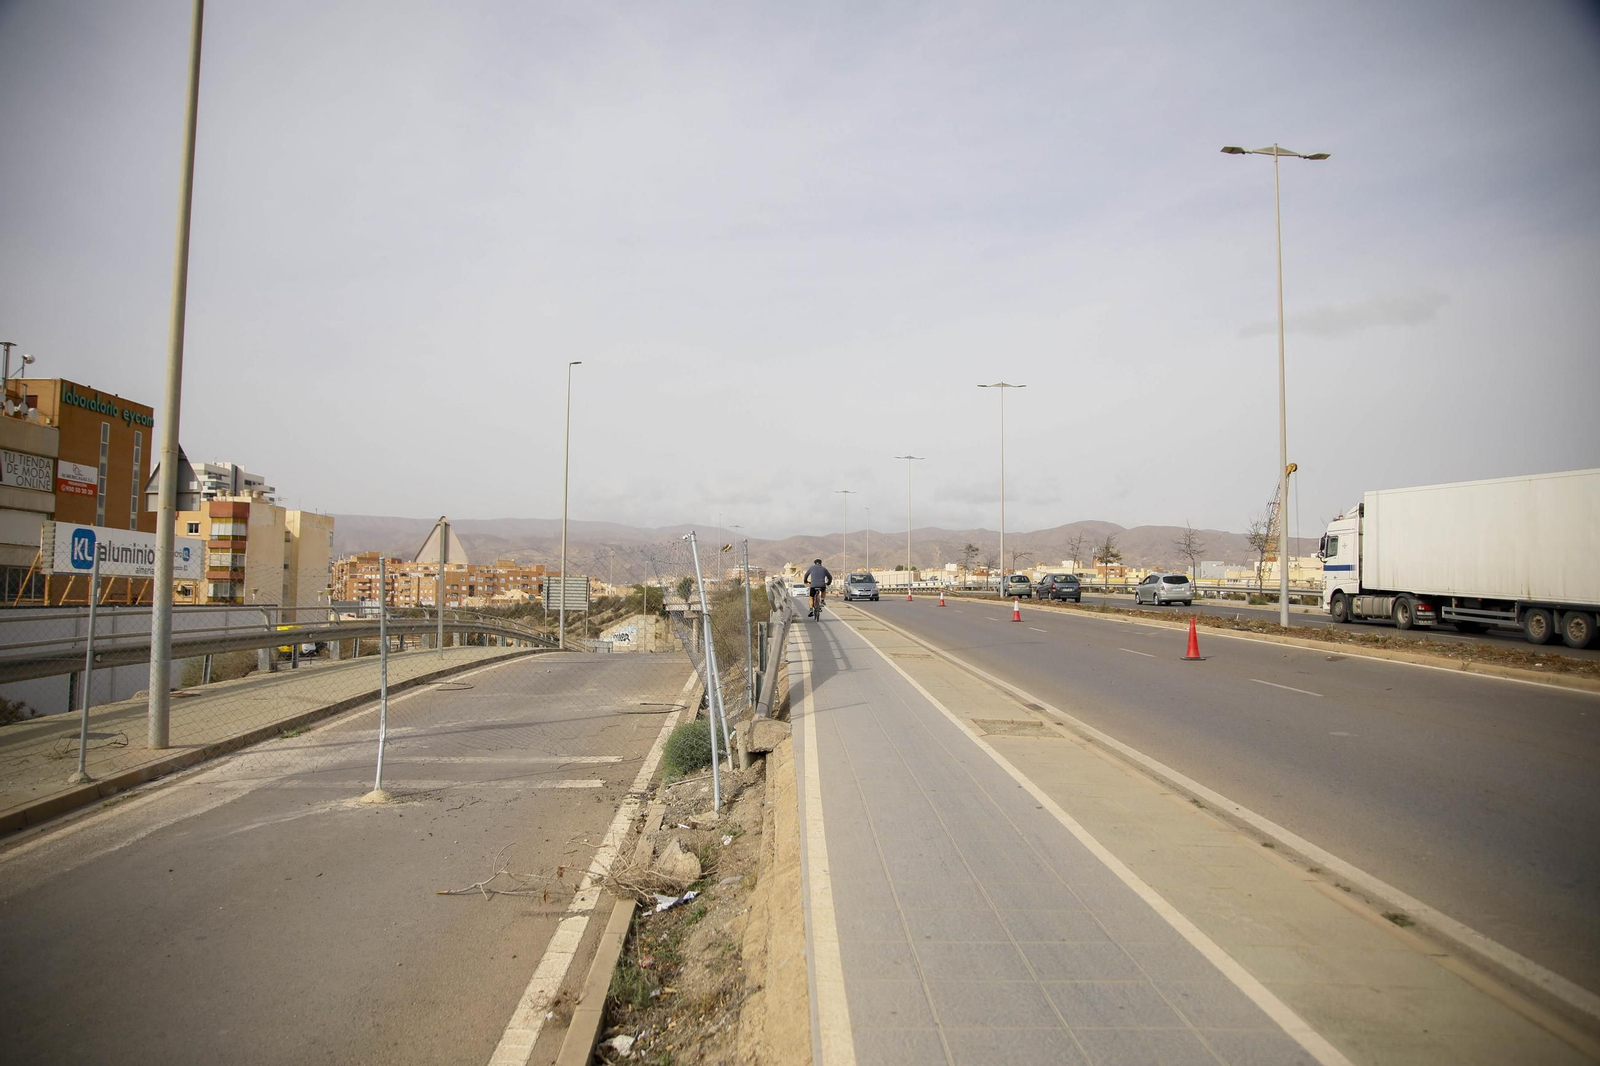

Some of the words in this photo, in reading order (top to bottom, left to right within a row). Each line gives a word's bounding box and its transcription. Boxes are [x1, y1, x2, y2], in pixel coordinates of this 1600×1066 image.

[62, 383, 119, 417] laboratorio
[123, 408, 154, 427] eycom
[4, 452, 15, 463] TU
[19, 454, 51, 470] TIENDA
[7, 463, 19, 475] DE
[22, 466, 50, 480] MODA
[16, 476, 50, 490] ONLINE
[74, 537, 93, 561] KL
[99, 540, 155, 565] aluminio
